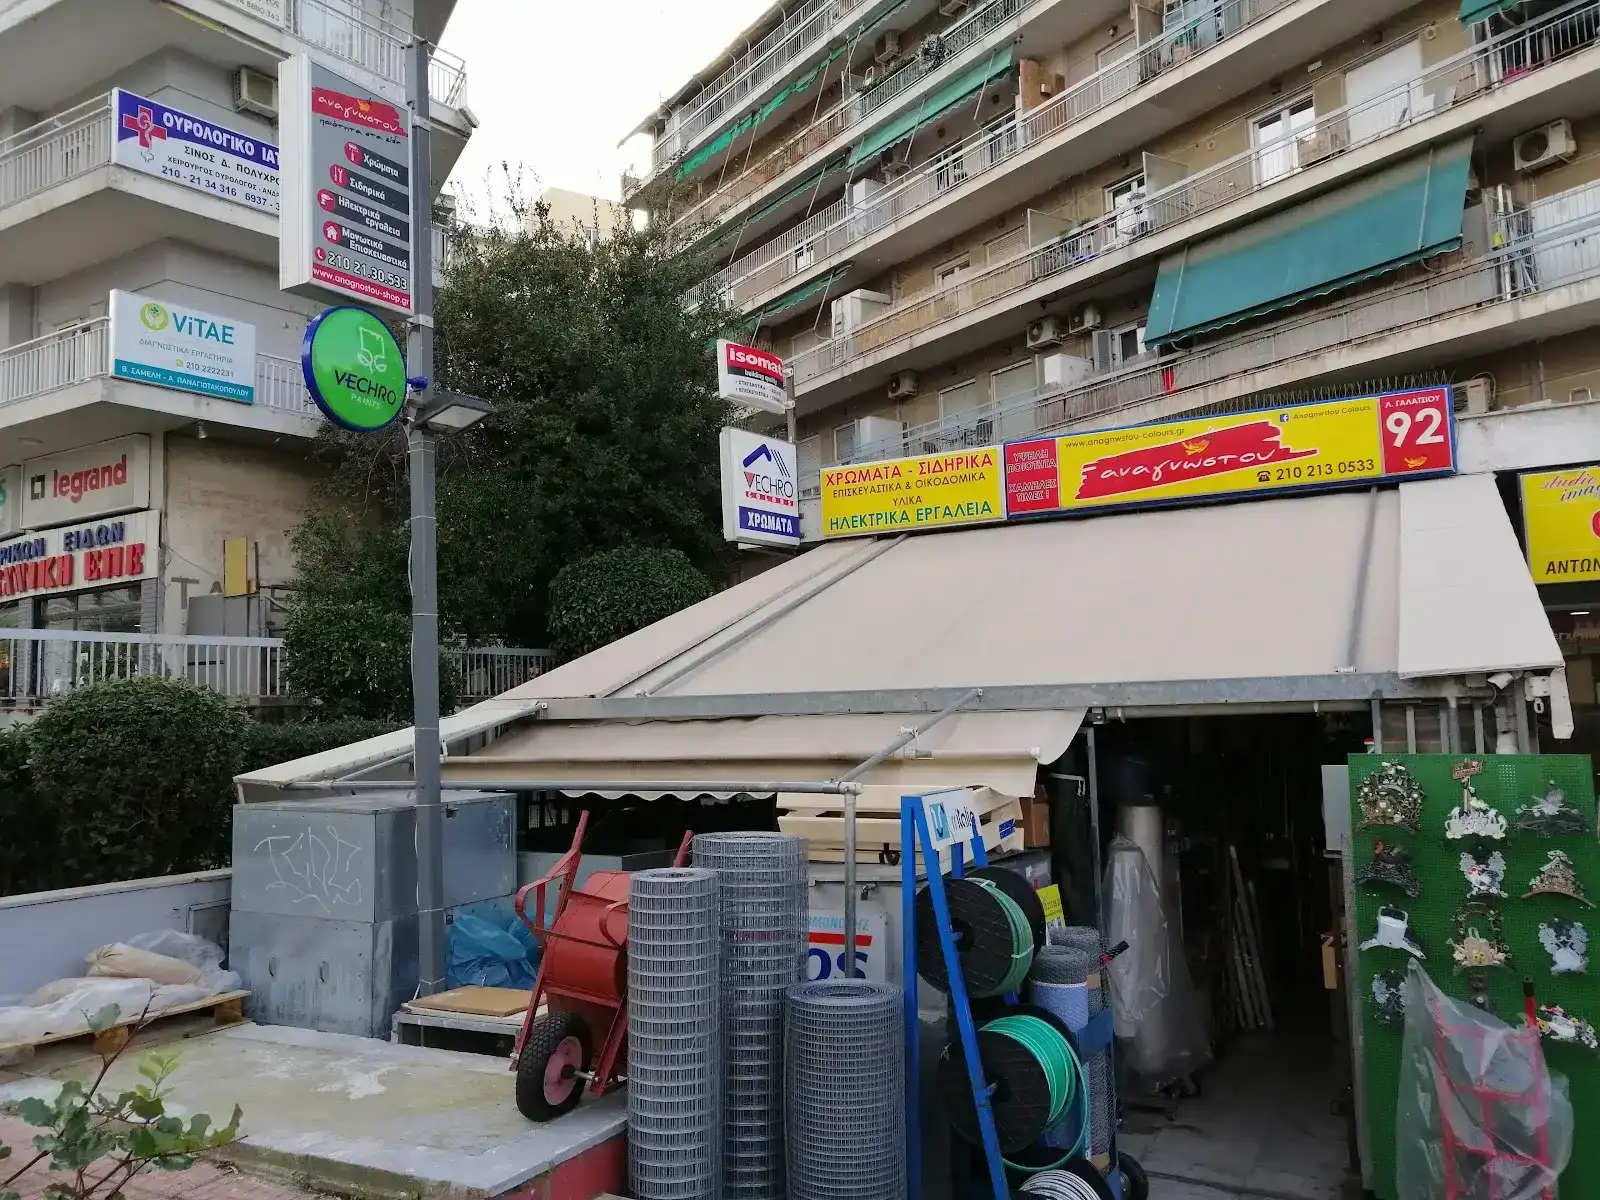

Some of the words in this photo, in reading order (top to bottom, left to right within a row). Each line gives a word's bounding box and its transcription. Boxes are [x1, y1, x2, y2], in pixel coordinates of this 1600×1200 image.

[163, 112, 254, 156] ΟΥΡΟΛΟΓΙΚΟ
[184, 146, 216, 164] ΣΙΝΟΣ
[221, 158, 231, 168] Δ.
[364, 153, 399, 178] Χρώματα
[162, 166, 181, 178] 210
[190, 174, 201, 186] 21
[205, 179, 216, 190] 34
[220, 184, 237, 197] 316
[245, 194, 266, 206] 6937
[168, 156, 213, 176] ΧΕΙΡΟΥΡΓΟΣ
[216, 172, 257, 191] ΟΥΡΟΛΟΓΟΣ
[349, 177, 386, 200] Σιδηρικά
[338, 196, 380, 220] Ηλεκτρικά
[342, 226, 383, 250] Μονωτικά
[349, 240, 408, 269] Επισκευαστικά
[328, 251, 350, 270] 210
[354, 262, 408, 290] 21.30.533
[312, 267, 410, 306] www.anagnostou-shop.gr
[140, 338, 190, 355] ΔΙΑΓΝΩΣΤΙΚΑ
[191, 350, 233, 364] ΕΡΓΑΣΤΗΡΙΑ
[730, 348, 783, 376] isomat
[186, 362, 200, 371] 210
[202, 366, 234, 378] 2222231
[334, 368, 397, 406] VECHRO
[350, 394, 381, 410] PAINTS
[1294, 408, 1340, 420] Anagnwstou
[1342, 404, 1371, 416] Colours
[1396, 394, 1441, 407] ΓΑΛΑΤΣΙΟΥ
[1064, 428, 1185, 448] www.anagnwstou-colours.gr
[1386, 407, 1445, 448] 92
[1008, 458, 1057, 474] ΠΟΙΟΤΗΤΑ
[1012, 448, 1048, 462] ΥΨΗΛΗ
[53, 454, 127, 504] legrand
[826, 464, 902, 487] ΧΡΩΜΑΤΑ
[918, 452, 993, 476] ΣΙΔΗΡΙΚΑ
[1276, 466, 1302, 481] 210
[1306, 463, 1334, 478] 213
[1338, 458, 1375, 474] 0533
[744, 471, 794, 498] VECHRO
[832, 481, 902, 498] ΕΠΙΣΚΕΥΑΣΤΙΚΑ
[905, 480, 912, 490] &
[916, 471, 986, 489] ΟΙΚΟΔΟΜΙΚΑ
[1008, 479, 1056, 493] ΧΑΜΗΛΕΣ
[1016, 490, 1044, 502] ΤΙΜΕΣ
[892, 494, 923, 506] ΥΛΙΚΑ
[747, 512, 794, 534] ΧΡΩΜΑΤΑ
[830, 508, 911, 531] ΗΛΕΚΤΡΙΚΑ
[916, 500, 992, 522] ΕΡΓΑΛΕΙΑ
[64, 522, 124, 552] ΕΙΔΩΝ
